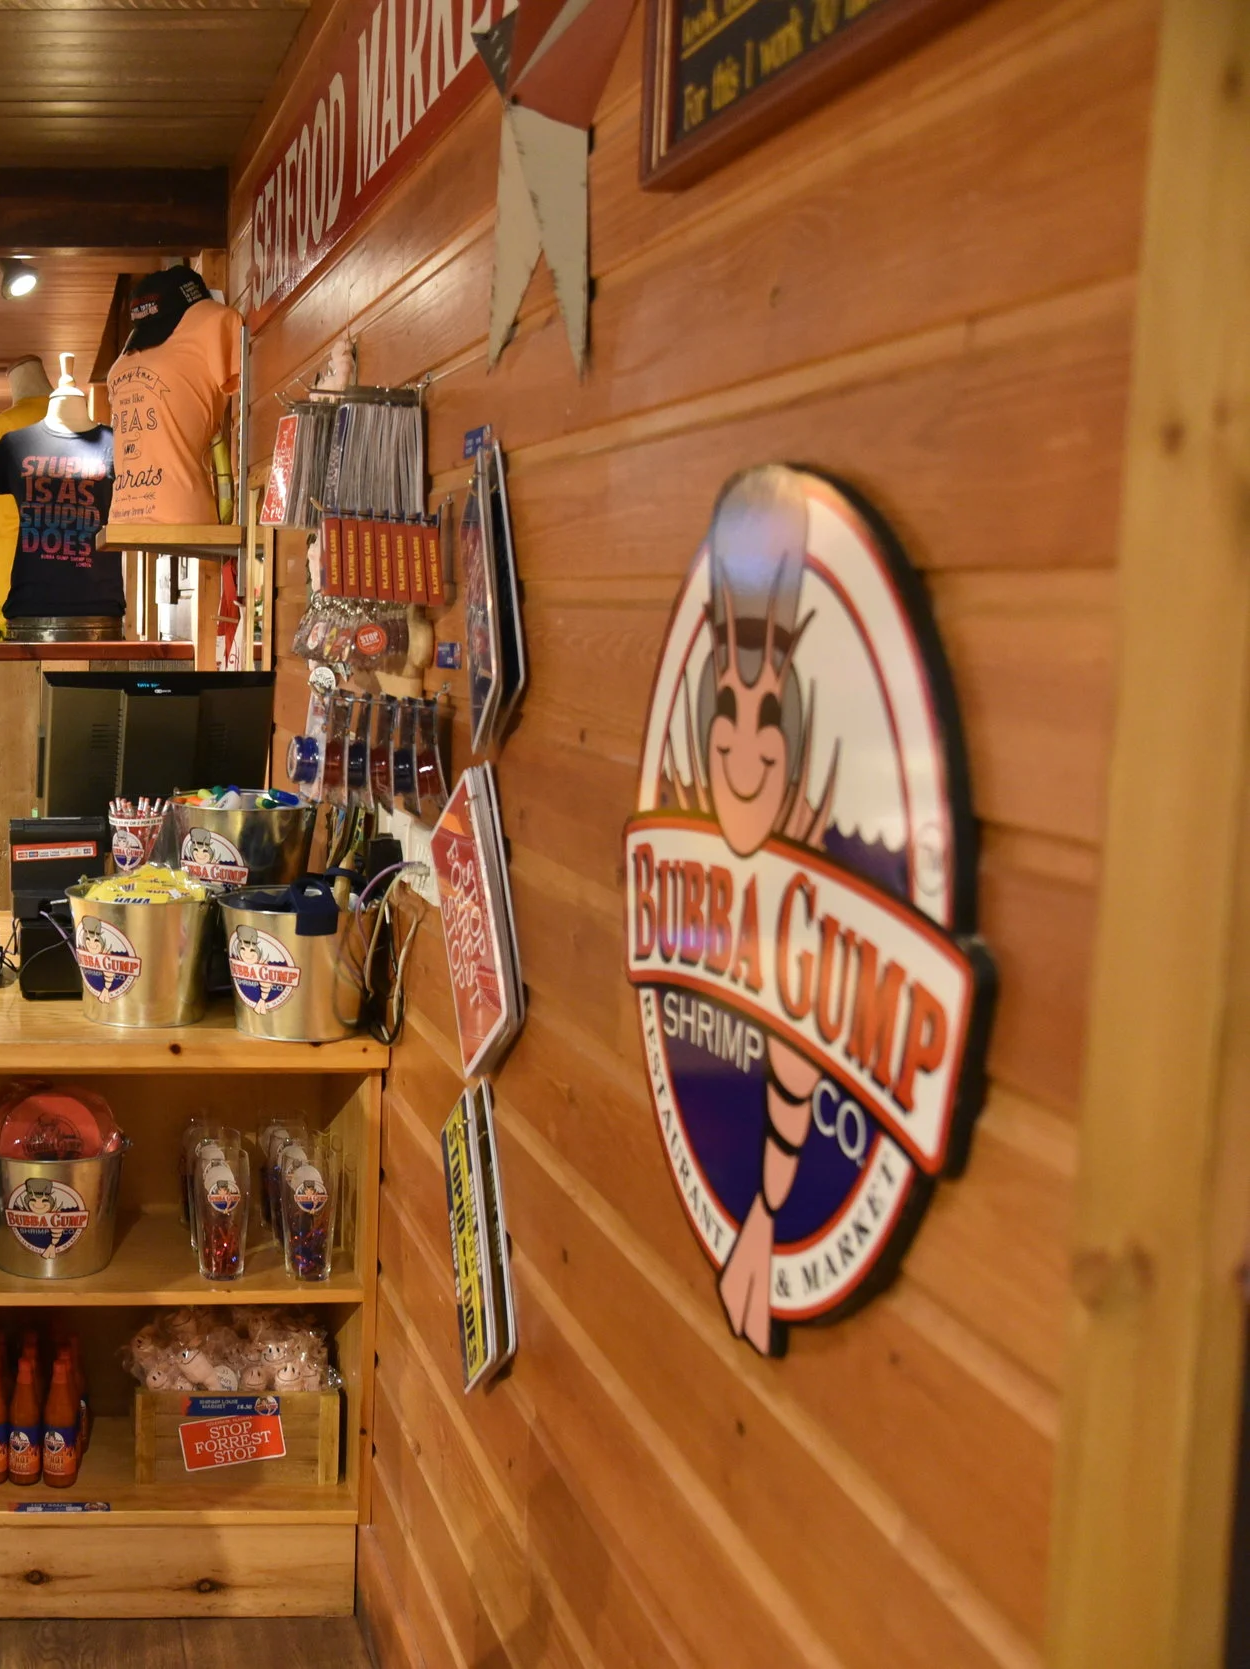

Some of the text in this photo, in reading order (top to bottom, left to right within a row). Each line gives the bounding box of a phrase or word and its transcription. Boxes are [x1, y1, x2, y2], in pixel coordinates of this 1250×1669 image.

[253, 0, 491, 312] SEAFOOD MARKE
[120, 393, 144, 405] was like
[21, 456, 106, 480] STUPID
[26, 477, 94, 506] IS AS
[21, 502, 100, 532] STUPID
[22, 528, 91, 556] DOES
[364, 555, 372, 587] PLAYING
[397, 559, 405, 591] PLAYING
[414, 560, 422, 592] PLAYING
[430, 563, 439, 594] PLAYING
[359, 631, 379, 644] STOP
[126, 849, 144, 857] GUMP
[211, 867, 248, 881] GUMP
[462, 859, 486, 957] STOP
[445, 838, 482, 1008] FORREST
[440, 901, 466, 990] STOP
[102, 957, 139, 973] GUMP
[258, 966, 299, 983] GUMP
[633, 843, 763, 996] BUBBA
[775, 871, 948, 1115] GUMP
[236, 978, 258, 988] SHRIMP
[663, 992, 764, 1074] SHRIMP
[642, 993, 896, 1299] RESTAURANT & MARKET
[7, 1211, 87, 1227] BUBBA GUMP
[447, 1124, 478, 1369] STUPID DOES
[448, 1210, 459, 1269] SHRIMP
[195, 1430, 271, 1454] FORREST
[210, 1421, 252, 1439] STOP
[214, 1446, 257, 1464] STOP
